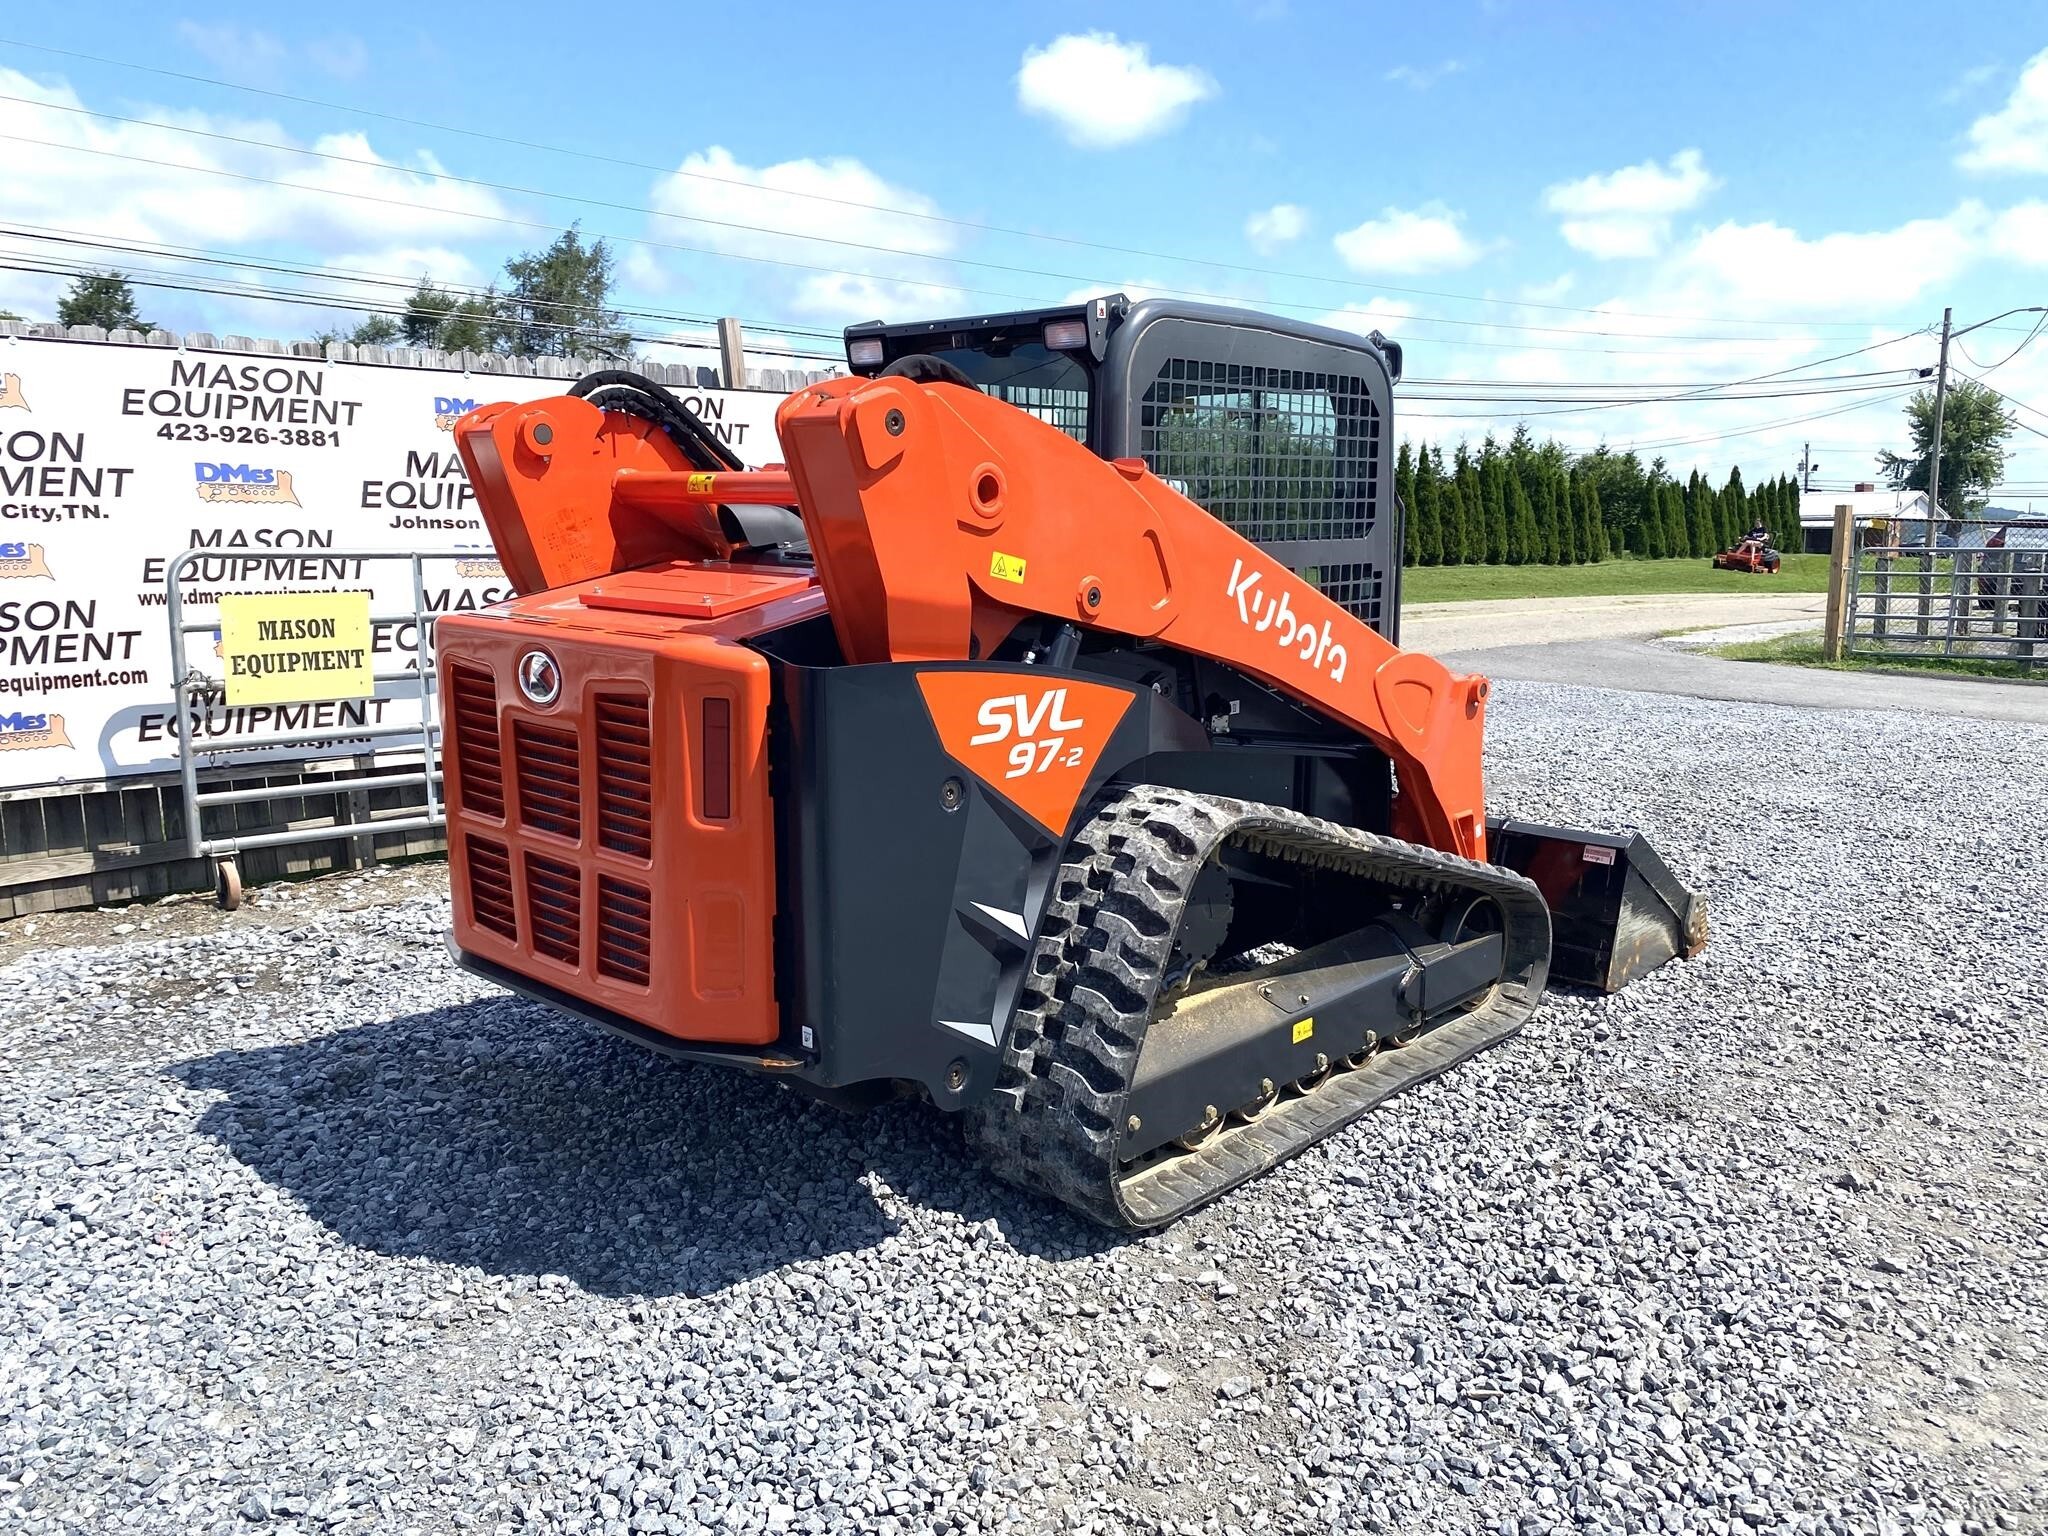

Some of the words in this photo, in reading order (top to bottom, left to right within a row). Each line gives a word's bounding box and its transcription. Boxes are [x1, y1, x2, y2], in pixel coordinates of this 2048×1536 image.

[171, 360, 323, 396] MASON
[121, 388, 363, 426] EQUIPMENT
[434, 397, 483, 415] DM
[0, 430, 84, 462] ON
[157, 423, 340, 447] 423-926-3881
[389, 516, 480, 530] Johnson
[189, 528, 333, 548] MASON
[142, 557, 370, 583] EQUIPMENT
[423, 588, 519, 611] MAS
[258, 618, 335, 641] MASON
[1226, 558, 1347, 683] Kubota
[231, 649, 365, 678] EQUIPMENT
[138, 698, 391, 742] EQUIPMENT
[970, 689, 1084, 746] SVL
[1005, 737, 1084, 779] 97-2
